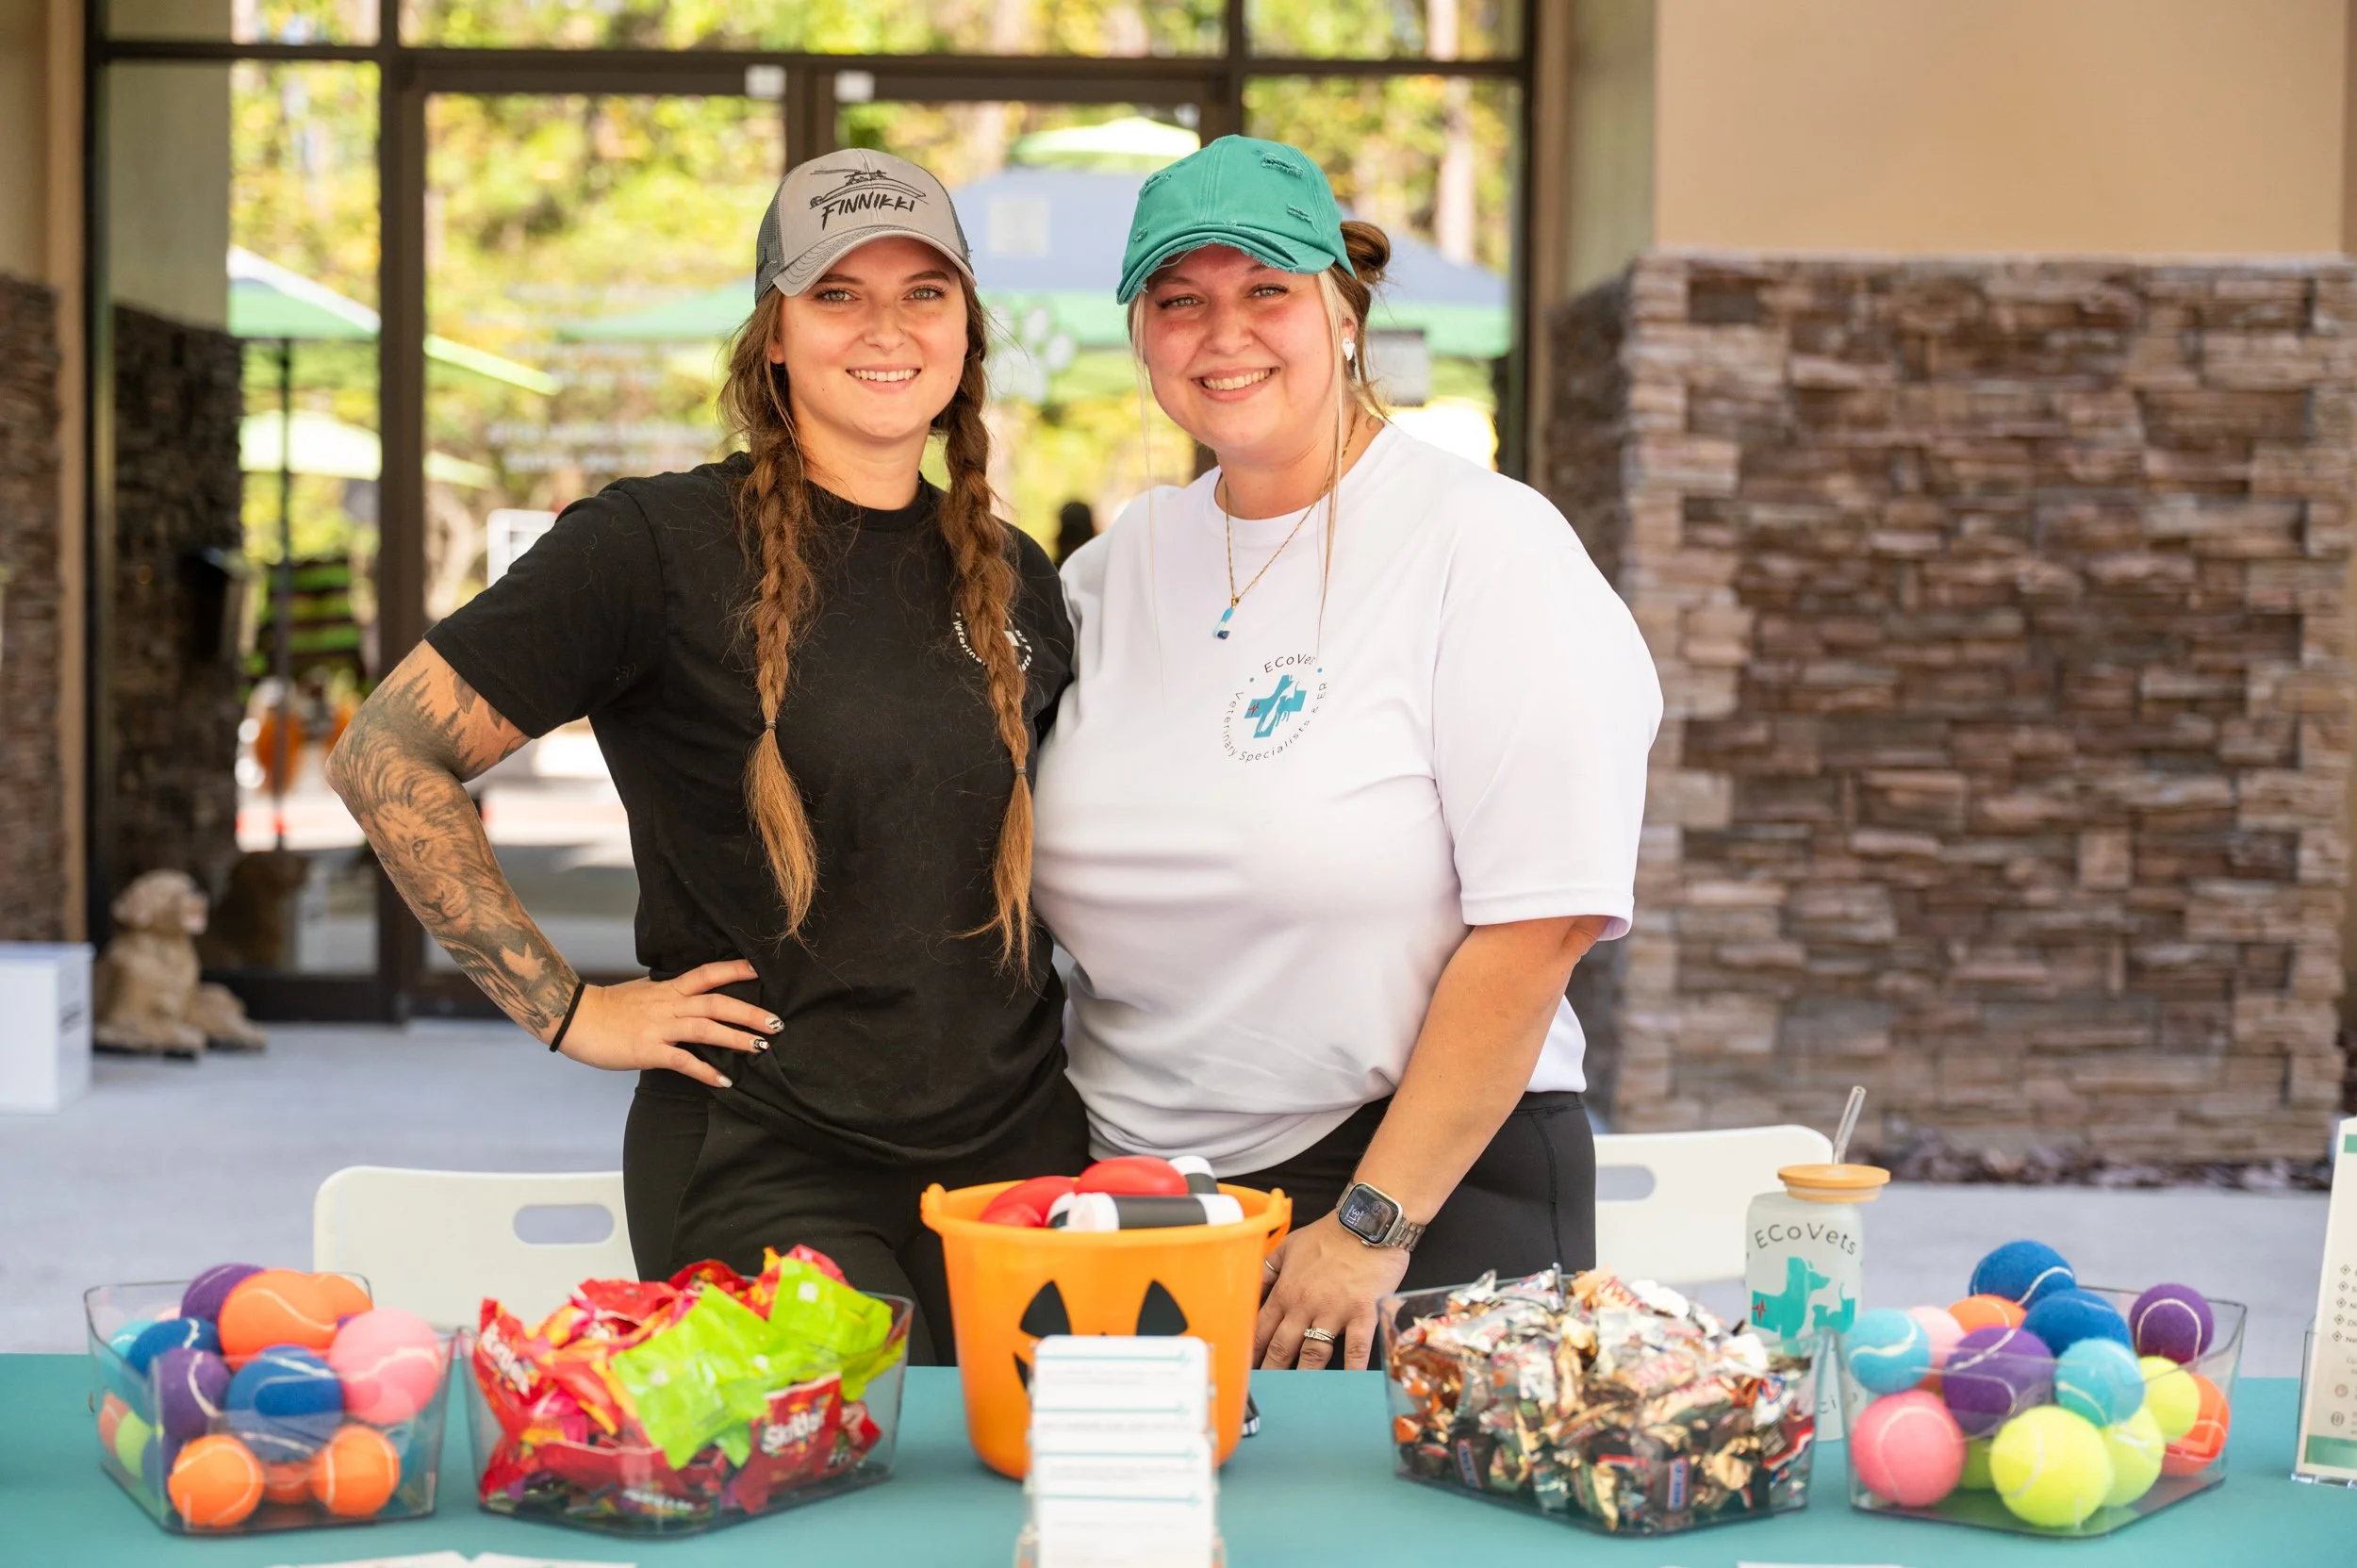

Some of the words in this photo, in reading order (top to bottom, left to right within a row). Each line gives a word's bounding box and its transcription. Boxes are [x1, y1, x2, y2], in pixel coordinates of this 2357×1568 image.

[821, 191, 915, 231] FINNIKKI
[953, 621, 986, 666] Veterina
[1223, 691, 1244, 757] Veterinary
[1239, 720, 1310, 763] Specialists
[1755, 1223, 1856, 1256] ECoVets
